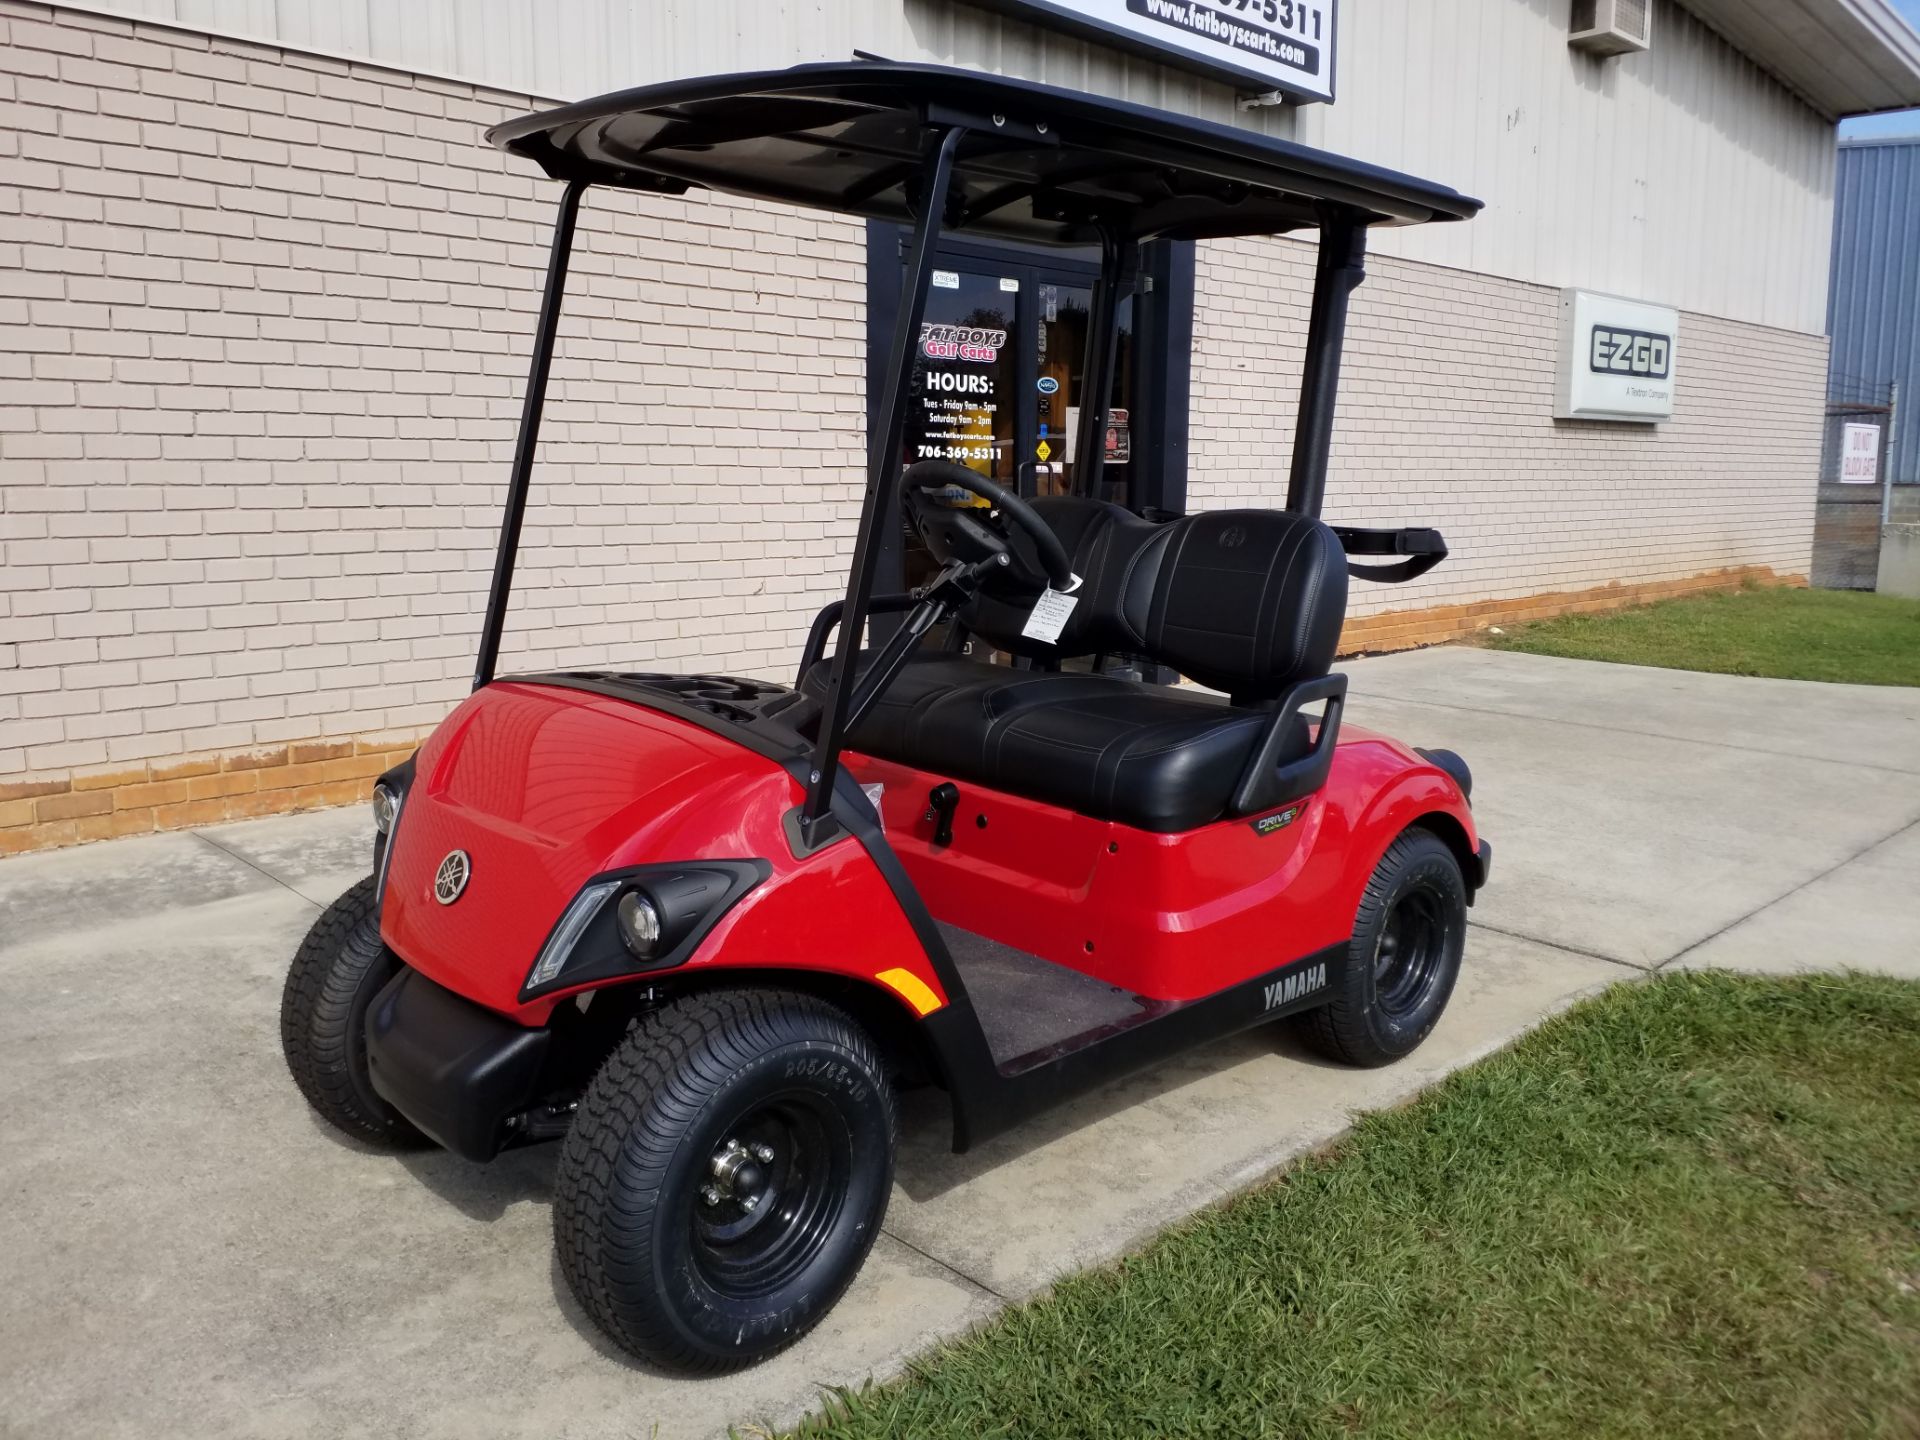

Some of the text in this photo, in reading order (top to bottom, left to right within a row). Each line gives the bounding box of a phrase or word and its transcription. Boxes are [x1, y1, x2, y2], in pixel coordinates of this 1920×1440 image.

[1218, 0, 1321, 41] -5311
[1146, 0, 1305, 65] www.fatboyscarts.com
[920, 324, 1006, 348] FAT BOYS
[925, 341, 995, 361] Golf Carts
[927, 372, 993, 394] HOURS:
[924, 398, 938, 409] Tues
[944, 399, 963, 412] Friday
[964, 401, 978, 411] 9am
[984, 402, 997, 414] 5pm
[930, 413, 957, 425] Saturday
[959, 414, 973, 424] 9am
[978, 416, 992, 427] 2pm
[925, 431, 996, 441] www.fatboyscarts.com
[918, 445, 1002, 459] 706-369-5311
[1264, 962, 1326, 1010] YAMAHA
